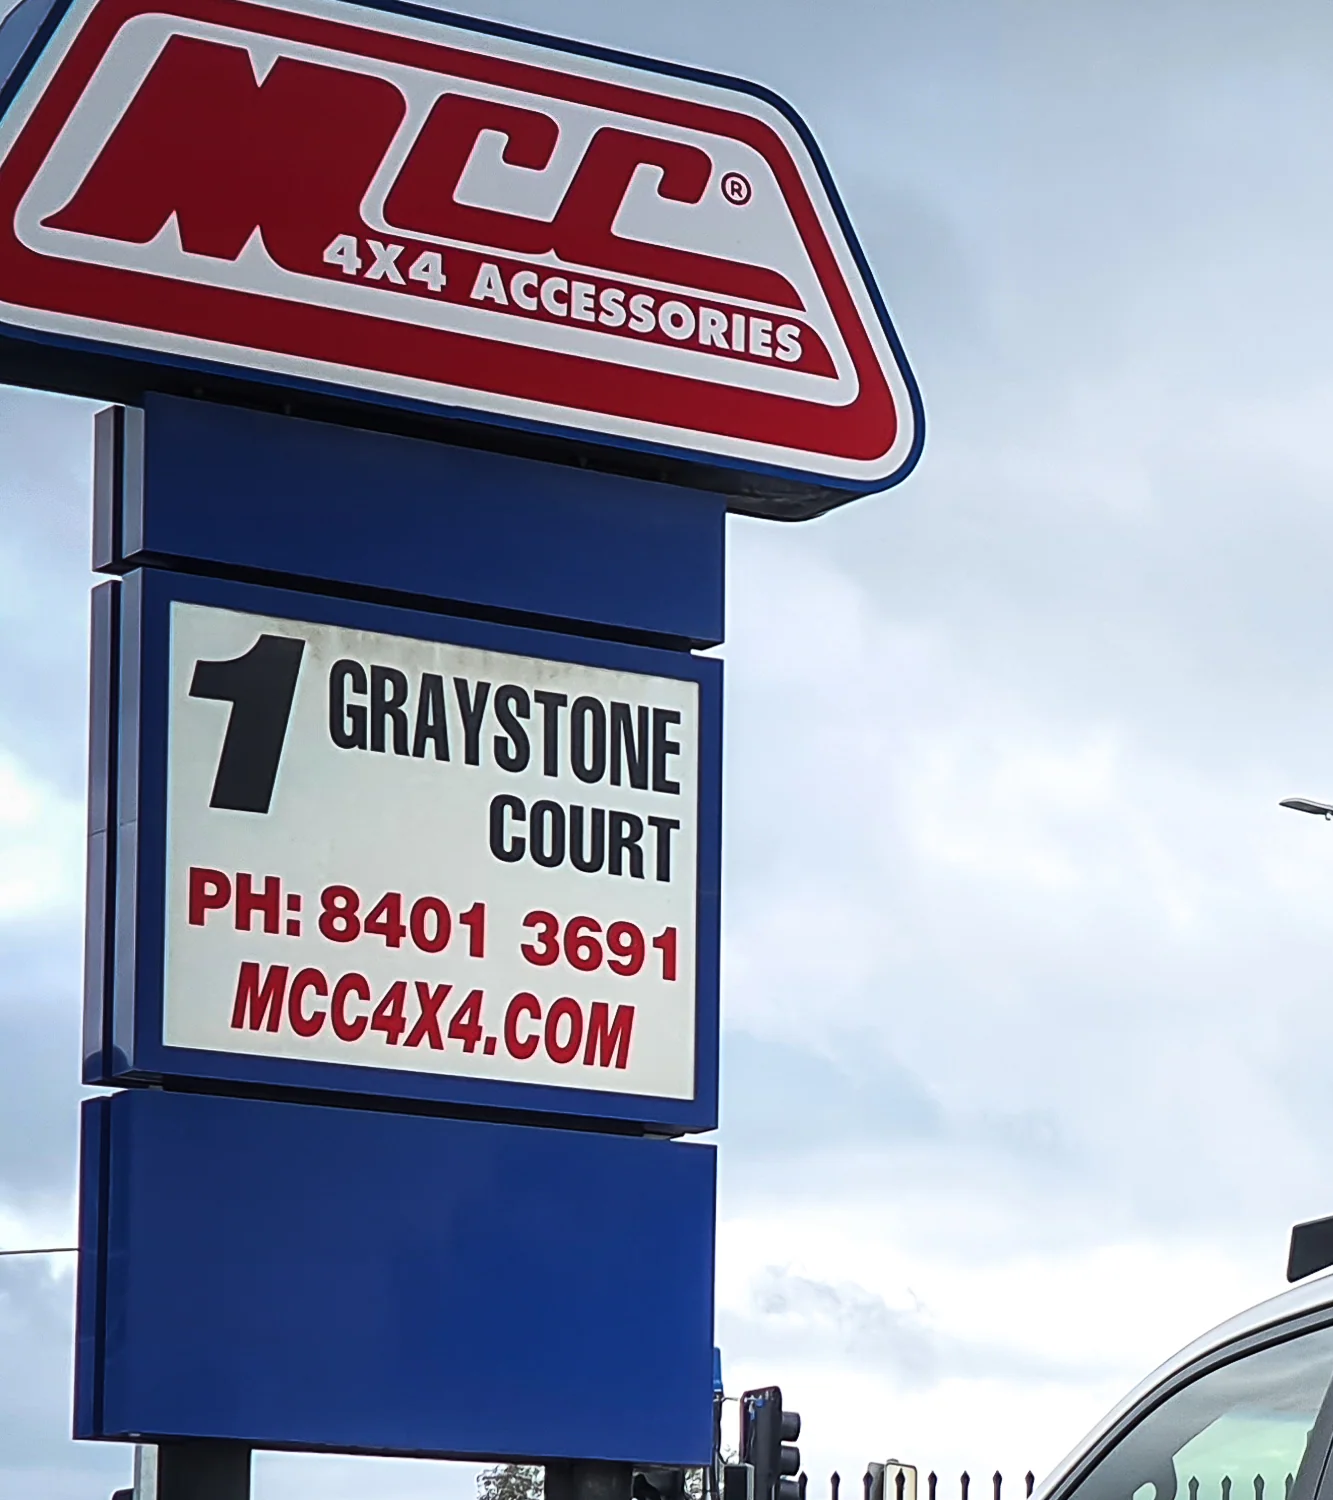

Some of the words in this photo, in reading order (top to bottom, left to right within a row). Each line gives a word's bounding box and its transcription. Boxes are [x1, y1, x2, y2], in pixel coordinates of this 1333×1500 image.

[39, 33, 807, 312] MCC
[323, 234, 447, 293] 4X4
[471, 264, 804, 364] ACCESSORIES
[188, 634, 306, 815] 1
[328, 659, 681, 796] GRAYSTONE
[489, 793, 680, 883] COURT
[187, 867, 302, 938] PH:
[317, 885, 487, 959] 8401
[519, 911, 678, 981] 3691
[230, 961, 635, 1071] MCC4X4.COM
